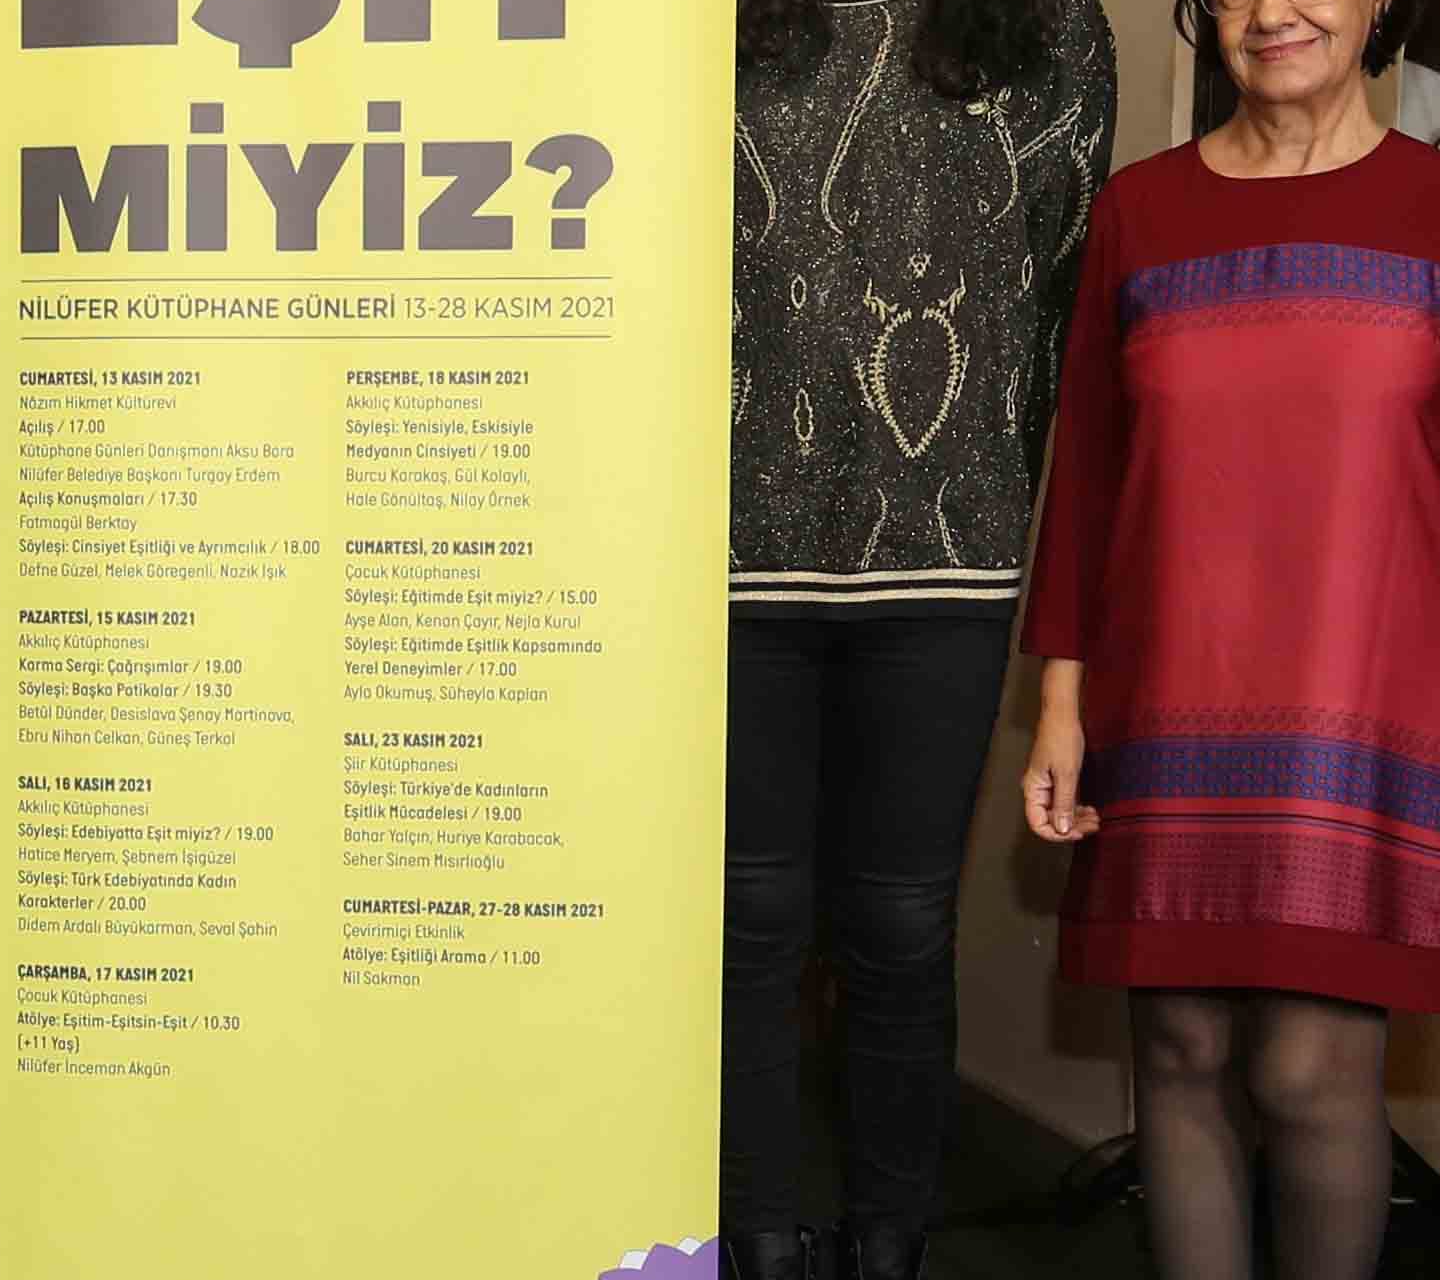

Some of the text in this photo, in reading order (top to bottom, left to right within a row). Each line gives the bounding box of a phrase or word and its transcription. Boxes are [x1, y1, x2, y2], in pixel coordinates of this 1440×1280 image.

[21, 101, 613, 253] MİYİZ?
[19, 293, 613, 320] NİLÜFER KÜTÜPHANE GÜNLERİ 13-28 KASIM 2021
[20, 369, 200, 387] CUMARTESİ, 13 KASIM 2021
[347, 371, 529, 387] PERŞEMBE, 18 KASIM 2021
[20, 420, 54, 437] Açılış
[70, 419, 104, 434] 17.00
[346, 419, 533, 437] Söyleşi: Yenisiyle, Eskisiyle
[346, 444, 412, 461] Medyanın
[416, 443, 476, 461] Cinsiyeti
[493, 444, 530, 458] 19.00
[20, 491, 54, 508] Açılış
[58, 491, 144, 508] Konuşmaları
[161, 491, 197, 506] 17.30
[19, 538, 68, 556] Söyleşi:
[72, 539, 126, 556] Cinsiyet
[130, 539, 176, 557] Eşitliği
[180, 544, 195, 554] ve
[198, 540, 266, 557] Ayrımcılık
[283, 540, 320, 554] 18.00
[346, 538, 533, 556] CUMARTESİ, 20 KASIM 2021
[345, 588, 397, 606] Söyleşi:
[402, 589, 463, 607] Eğitimde
[467, 590, 492, 606] Eşit
[496, 590, 542, 607] miyiz?
[559, 590, 597, 605] 15.00
[20, 608, 195, 626] PAZARTESİ, 15 KASIM 2021
[345, 636, 601, 656] Söyleşi: Eğitimde Eşitlik Kapsamında
[20, 657, 63, 672] Karma
[66, 658, 104, 676] Sergi:
[108, 659, 189, 676] Çağrışımlar
[205, 659, 241, 674] 19.00
[345, 660, 378, 675] Yerel
[383, 661, 461, 678] Deneyimler
[479, 662, 516, 677] 17.00
[19, 681, 69, 698] Söyleşi:
[72, 682, 112, 699] Başka
[117, 682, 178, 697] Patikalar
[195, 683, 232, 698] 19.30
[344, 733, 483, 748] SALI, 23 KASIM 2021
[18, 776, 152, 792] SALI, 16 KASIM 2021
[344, 780, 548, 799] Söyleşi: Türkiye'de Kadınların
[344, 804, 385, 821] Eşitlik
[390, 805, 467, 820] Mücadelesi
[485, 806, 521, 821] 19.00
[18, 823, 68, 840] Söyleşi:
[72, 824, 143, 842] Edebiyatta
[147, 826, 171, 843] Eşit
[175, 826, 220, 843] miyiz?
[237, 826, 273, 840] 19.00
[18, 870, 236, 890] Söyleşi: Türk Edebiyatında Kadın
[18, 894, 93, 909] Karakterler
[109, 896, 146, 911] 20.00
[344, 898, 604, 917] CUMARTESİ-PAZAR, 27-28 KASIM 2021
[343, 947, 387, 964] Atölye:
[391, 947, 437, 966] Eşitliği
[441, 949, 486, 964] Arama
[503, 950, 540, 965] 11.00
[18, 964, 193, 982] ÇARŞAMBA, 17 KASIM 2021
[17, 1011, 59, 1028] Atölye:
[204, 1016, 240, 1030] 10.30
